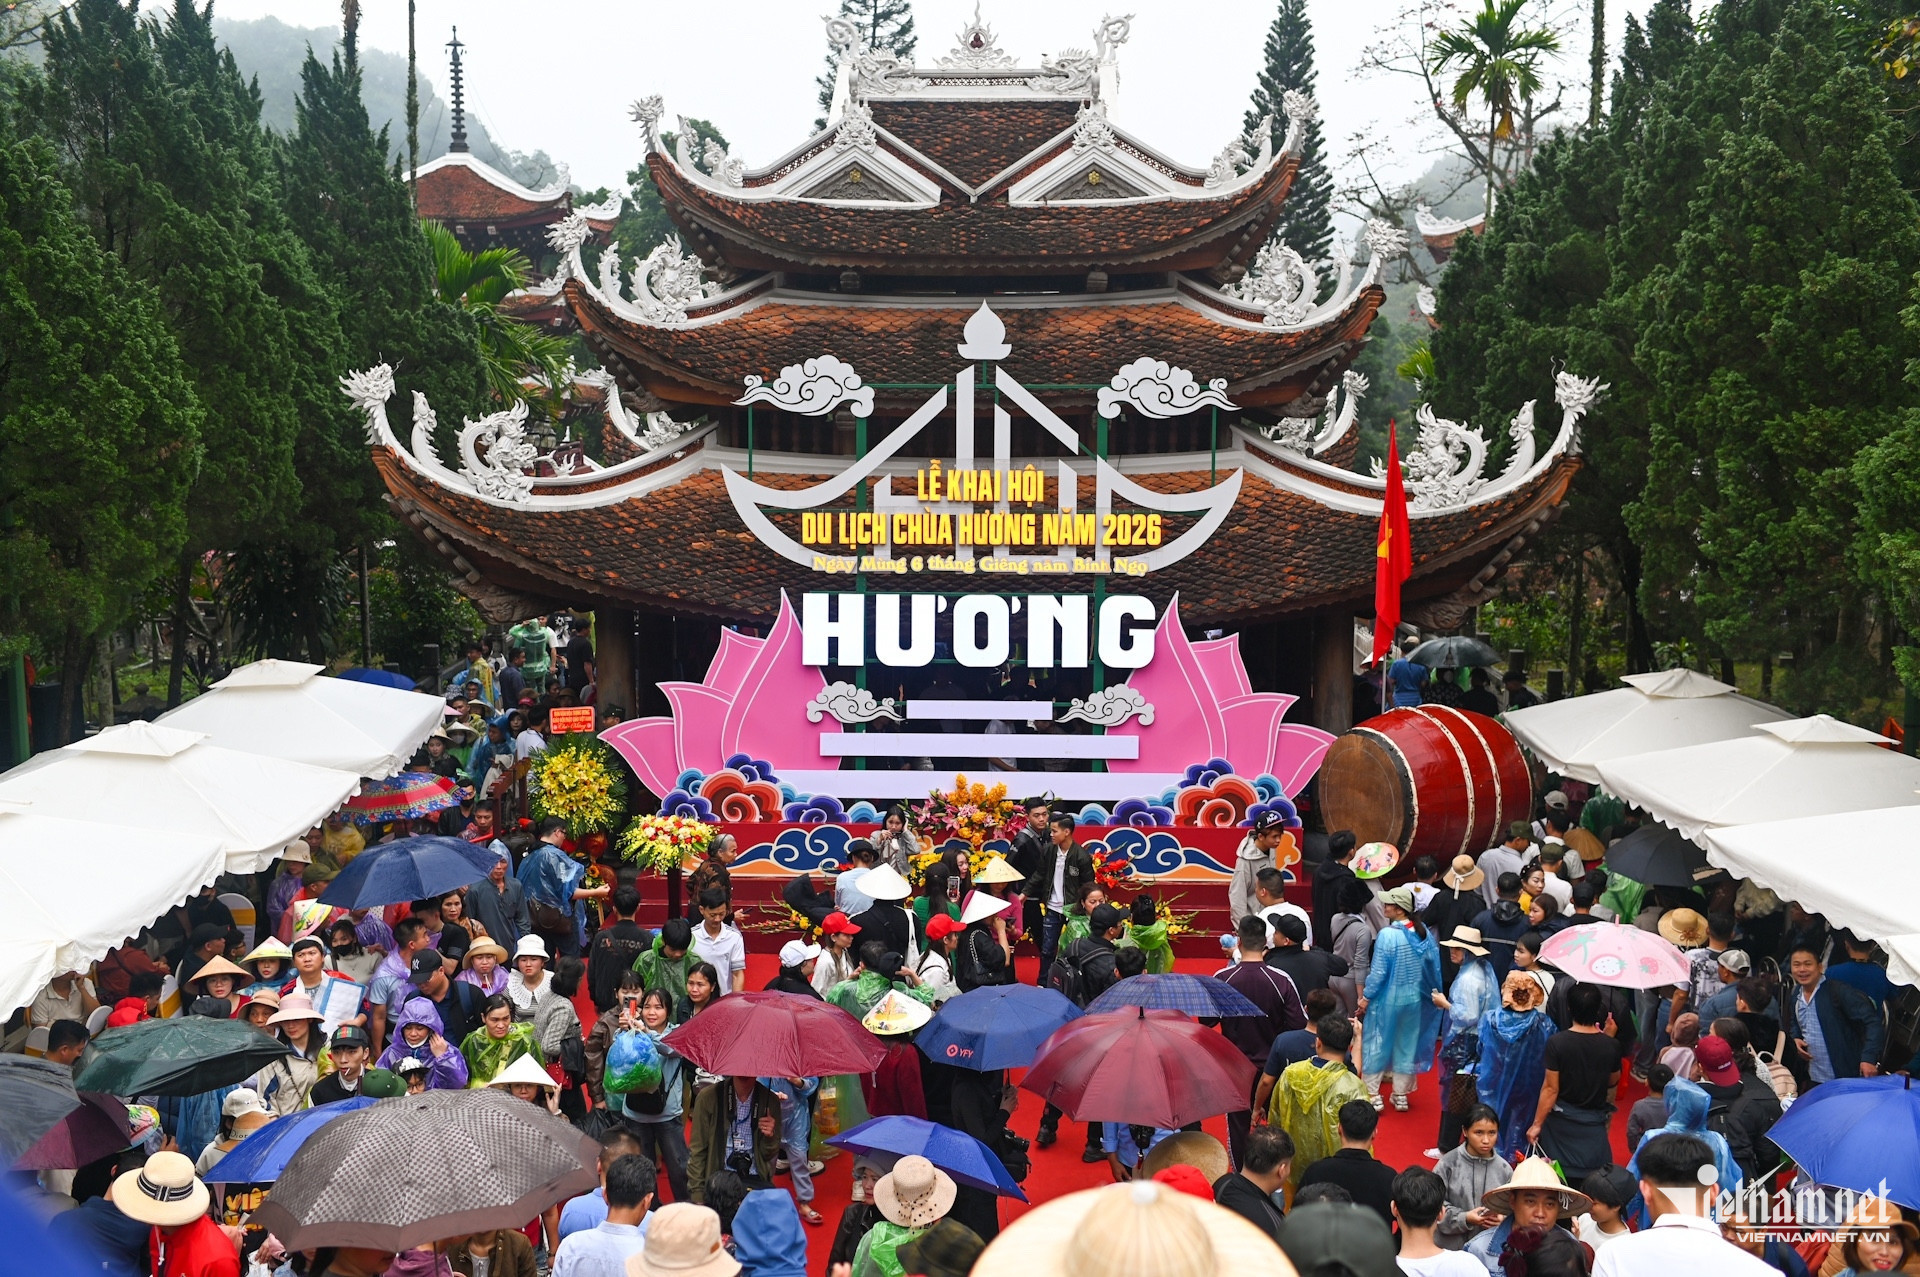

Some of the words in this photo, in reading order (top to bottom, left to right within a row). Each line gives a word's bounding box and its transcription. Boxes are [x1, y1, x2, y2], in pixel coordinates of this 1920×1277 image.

[917, 459, 941, 501] LỄ
[947, 469, 1000, 502] KHAI
[1008, 463, 1044, 508] HỘI
[801, 512, 832, 545] DU
[839, 512, 887, 550] LỊCH
[893, 506, 953, 546] CHÙA
[958, 509, 1036, 546] HƯƠNG
[1042, 507, 1096, 546] NĂM
[1102, 513, 1162, 546] 2026
[813, 556, 856, 574] Ngày
[860, 555, 907, 574] Mùng
[911, 556, 924, 572] 6
[927, 555, 975, 574] tháng
[979, 555, 1029, 574] Giêng
[1113, 556, 1149, 576] Ngọ
[802, 592, 1156, 669] HƯƠNG
[960, 1048, 974, 1059] YFY
